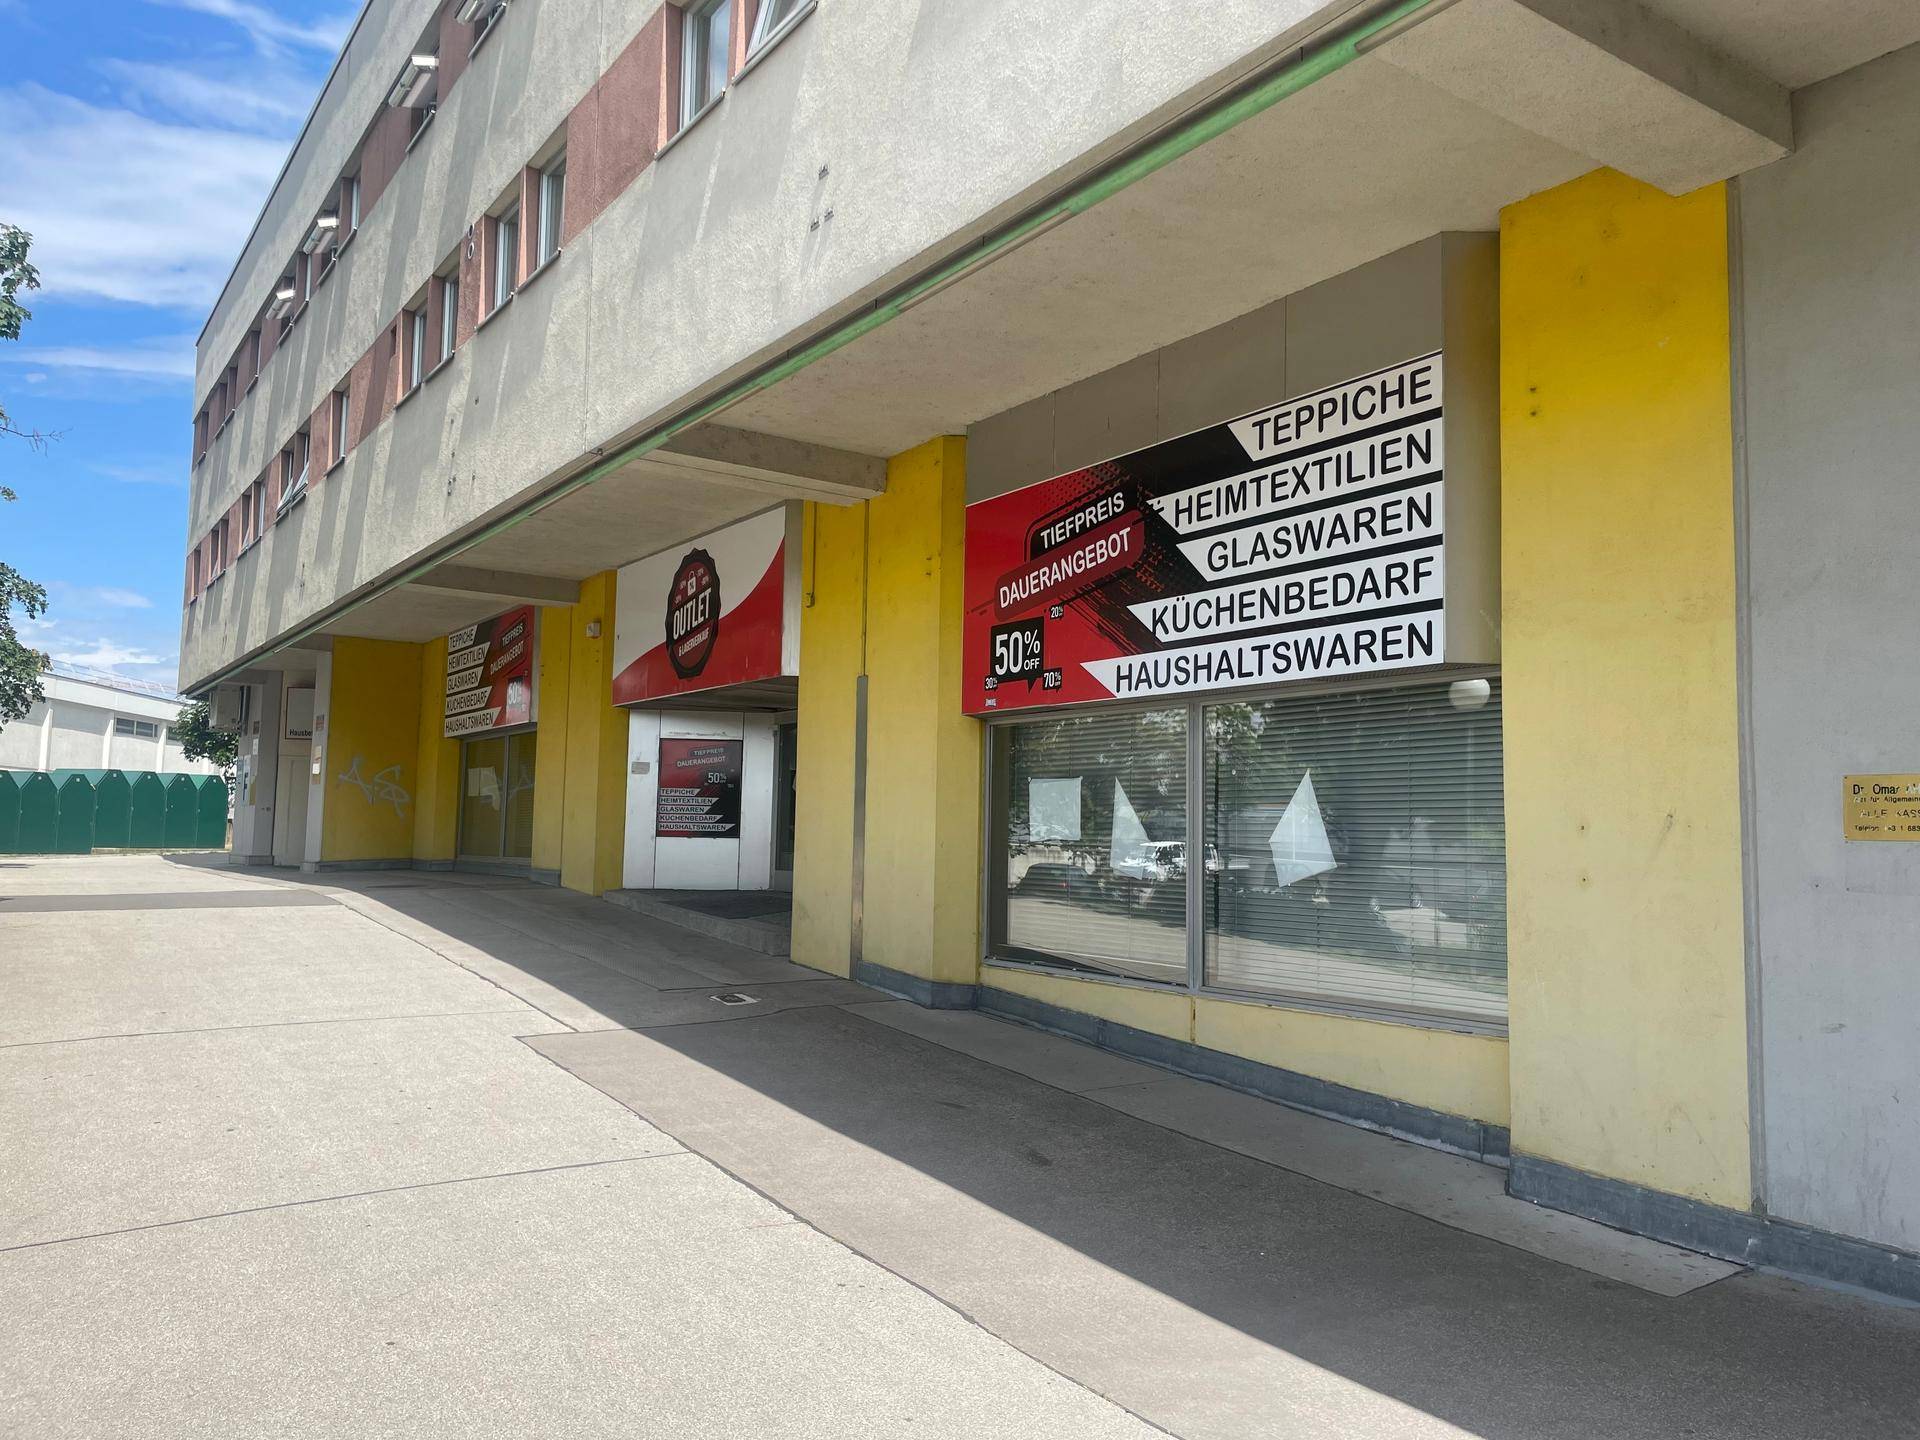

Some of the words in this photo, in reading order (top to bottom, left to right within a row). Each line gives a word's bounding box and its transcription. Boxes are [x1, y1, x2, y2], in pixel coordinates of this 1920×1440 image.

[1252, 365, 1432, 450] TEPPICHE
[1175, 428, 1432, 527] HEIMTEXTILIEN
[1040, 491, 1125, 549] TIEFPREIS
[1207, 492, 1432, 573] GLASWAREN
[1000, 527, 1131, 609] DAUERANGEBOT
[1152, 556, 1434, 636] KÜCHENBEDARF
[673, 587, 712, 640] OUTLET
[449, 629, 474, 648] TEPPICHE
[502, 622, 524, 647] TIEFPREIS
[448, 647, 485, 671] HEIMTEXTILIEN
[490, 640, 524, 675] DAUERANGEBOT
[995, 629, 1041, 675] 50%
[1023, 658, 1040, 671] OFF
[1116, 620, 1433, 693] HAUSHALTSWAREN
[447, 670, 479, 692] GLASWAREN
[445, 711, 494, 734] HAUSHALTSWAREN
[660, 797, 713, 805] HEIMTEXTILIEN
[661, 788, 696, 796] TEPPICHE
[1872, 784, 1900, 795] Omar
[660, 806, 705, 814] GLASWAREN
[659, 823, 727, 831] HAUSHALTSWAREN
